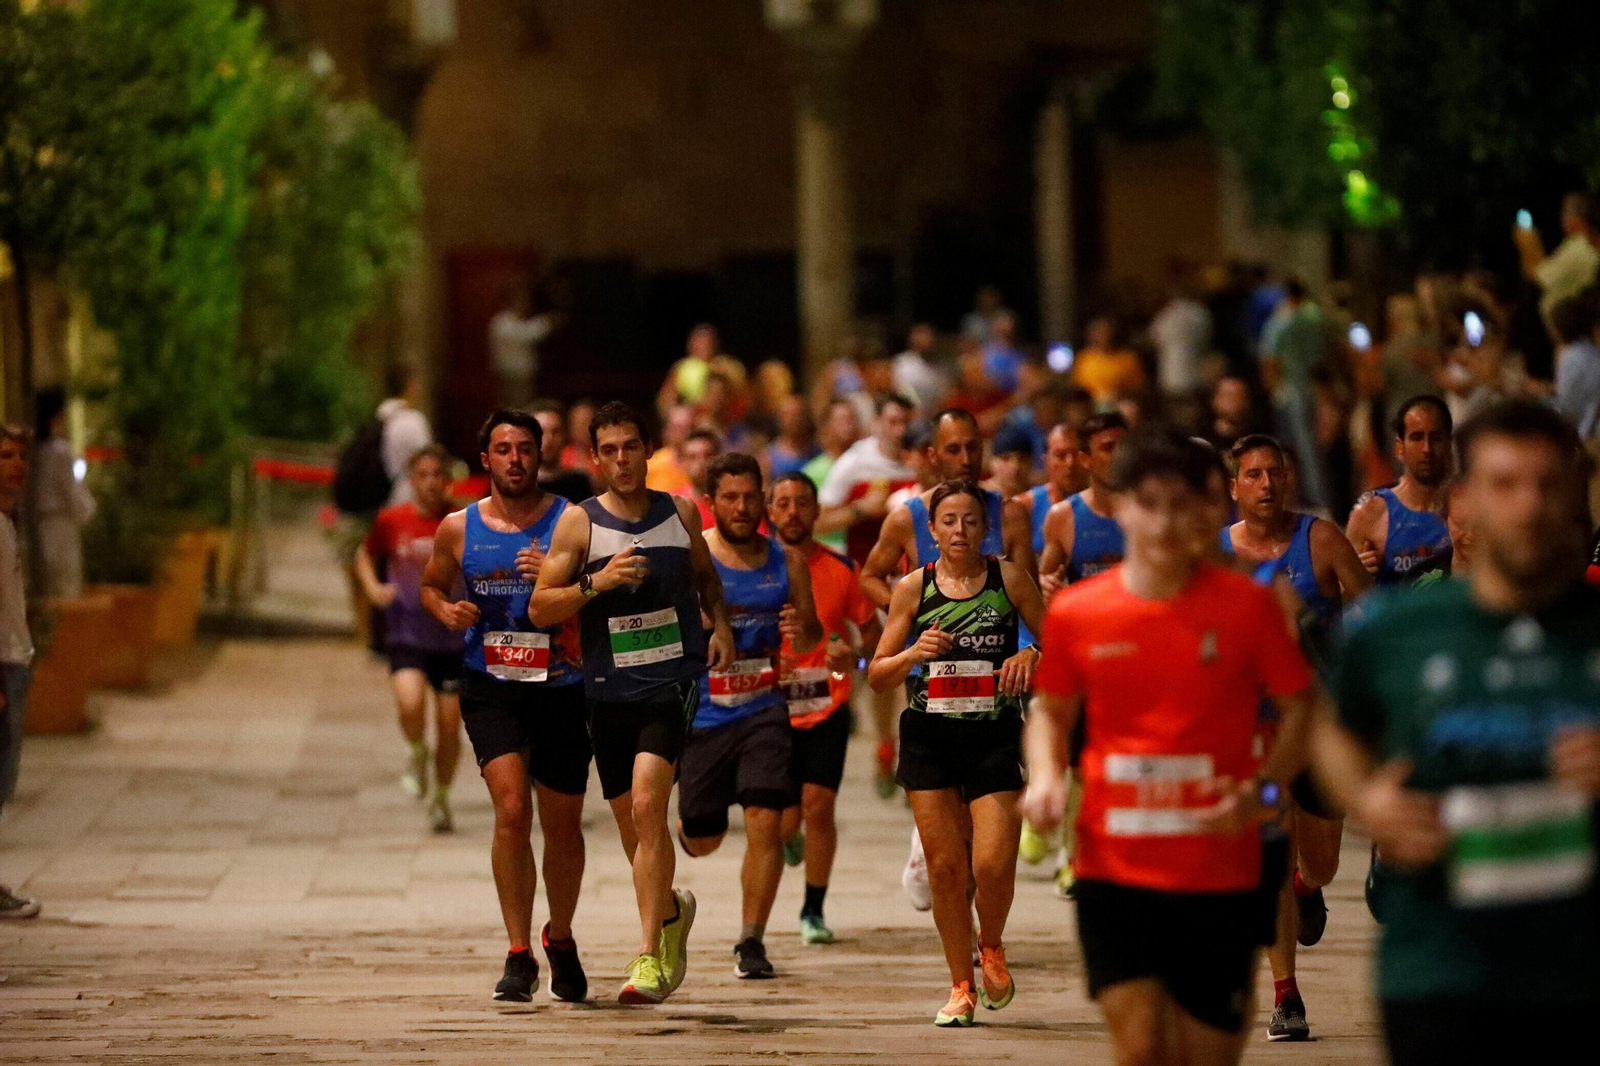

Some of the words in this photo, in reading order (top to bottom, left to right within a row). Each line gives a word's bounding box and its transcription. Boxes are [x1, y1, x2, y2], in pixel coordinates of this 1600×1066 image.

[1394, 556, 1412, 572] 20
[474, 580, 489, 595] 20
[629, 617, 643, 629] 20
[500, 634, 513, 644] 20
[632, 628, 662, 646] 576
[495, 647, 535, 663] 1340
[944, 664, 957, 675] 20
[723, 674, 762, 690] 1457
